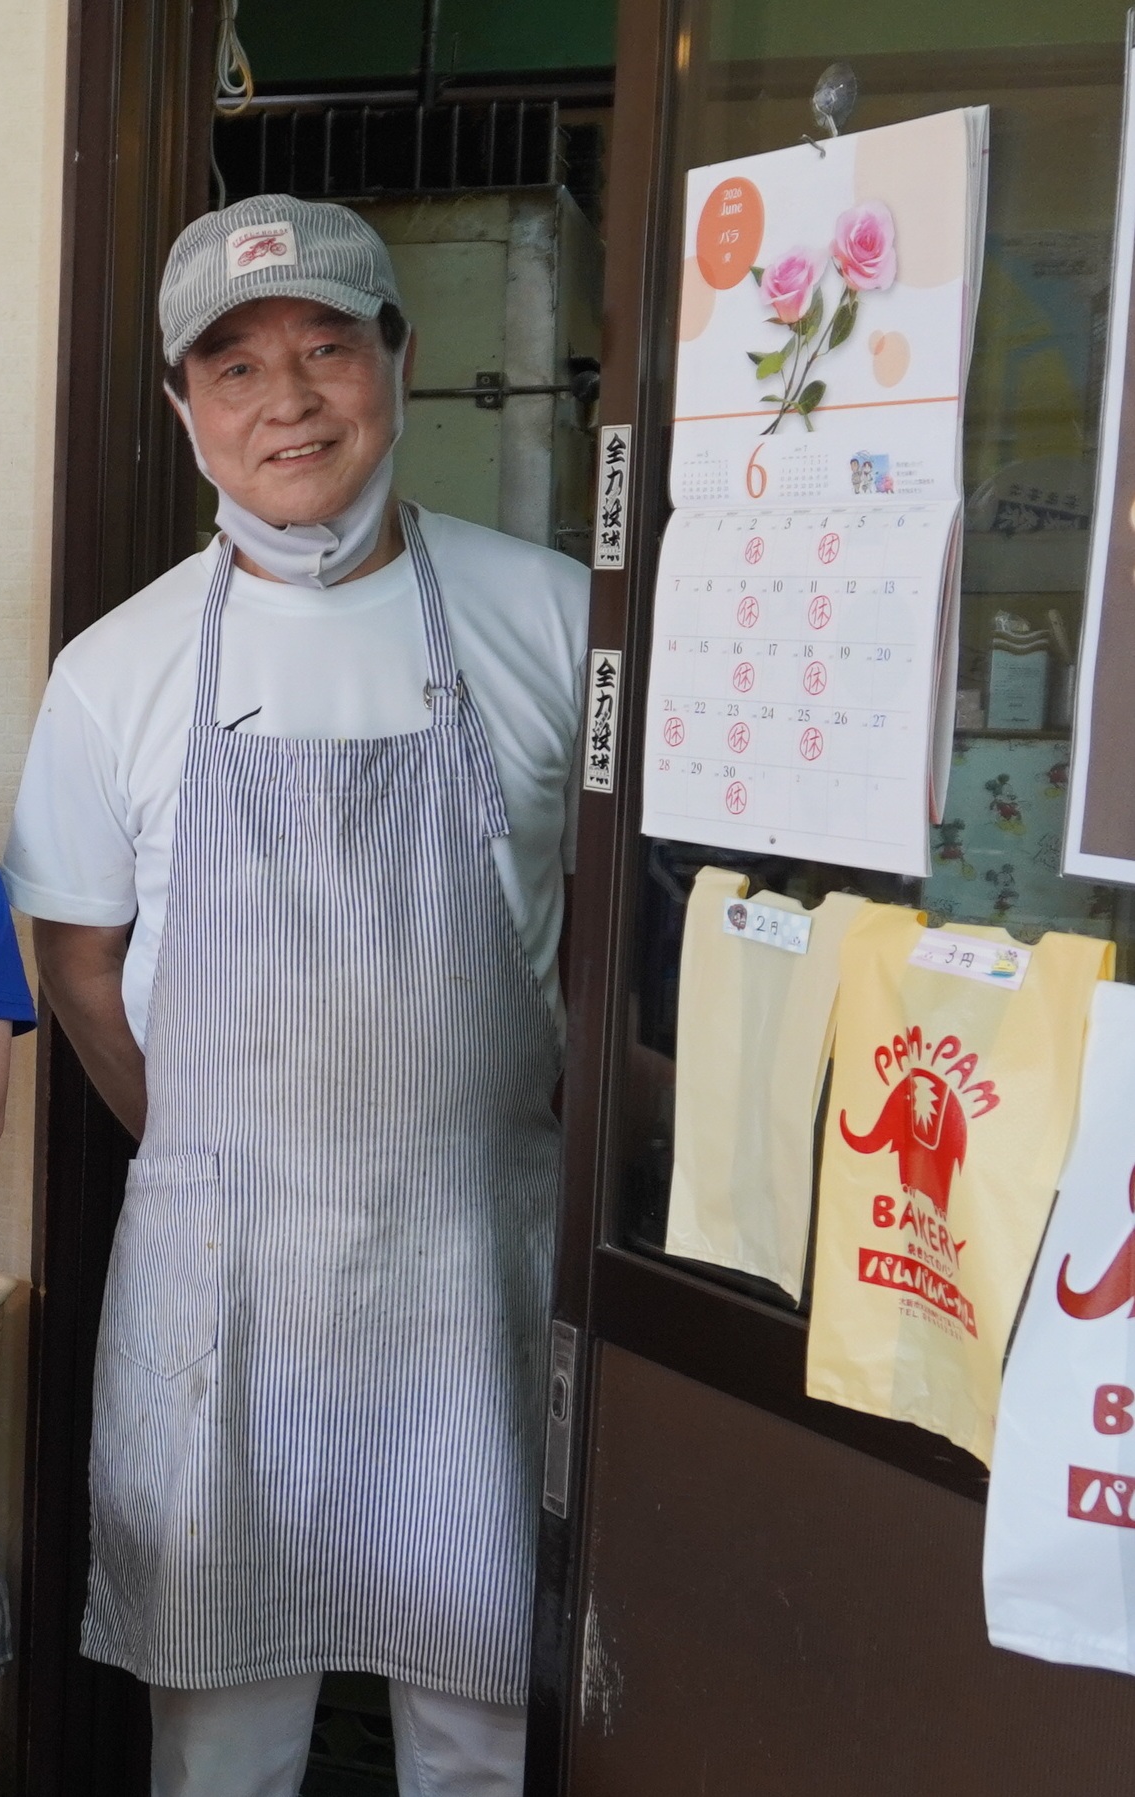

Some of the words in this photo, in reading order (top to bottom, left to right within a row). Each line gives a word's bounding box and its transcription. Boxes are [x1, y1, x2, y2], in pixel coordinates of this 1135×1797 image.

[724, 187, 742, 200] 2026
[721, 202, 743, 216] June
[719, 229, 739, 244] バラ
[746, 442, 767, 498] 6
[599, 432, 626, 562] 全力投球
[718, 520, 723, 531] 1
[749, 518, 757, 530] 2
[784, 518, 792, 529] 3
[821, 517, 828, 528] 4
[858, 516, 866, 527] 5
[898, 515, 904, 527] 6
[746, 538, 763, 563] 休
[819, 535, 839, 563] 休
[675, 580, 680, 591] 7
[707, 580, 712, 591] 8
[741, 580, 746, 592] 9
[773, 580, 783, 592] 10
[811, 581, 817, 593] 11
[847, 581, 856, 593] 12
[884, 581, 894, 594] 13
[738, 598, 758, 626] 休
[809, 597, 830, 627] 休
[669, 640, 676, 651] 14
[700, 641, 708, 653] 15
[734, 642, 742, 654] 16
[769, 644, 778, 655] 17
[804, 645, 813, 657] 18
[841, 647, 850, 659] 19
[876, 648, 891, 661] 20
[734, 664, 753, 691] 休
[804, 663, 826, 694] 休
[589, 657, 616, 785] 全力投球
[664, 699, 672, 711] 21
[695, 702, 705, 714] 22
[727, 704, 739, 716] 23
[762, 707, 773, 719] 24
[798, 709, 810, 722] 25
[834, 712, 847, 725] 26
[873, 714, 886, 727] 27
[665, 718, 683, 745] 休
[729, 724, 749, 752] 休
[801, 729, 822, 759] 休
[659, 759, 670, 771] 28
[691, 762, 702, 774] 29
[723, 766, 735, 778] 30
[727, 783, 746, 813] 休
[755, 914, 779, 936] 2円
[944, 944, 975, 968] 3円
[873, 1194, 967, 1270] BAKERY
[898, 1306, 919, 1318] TEL
